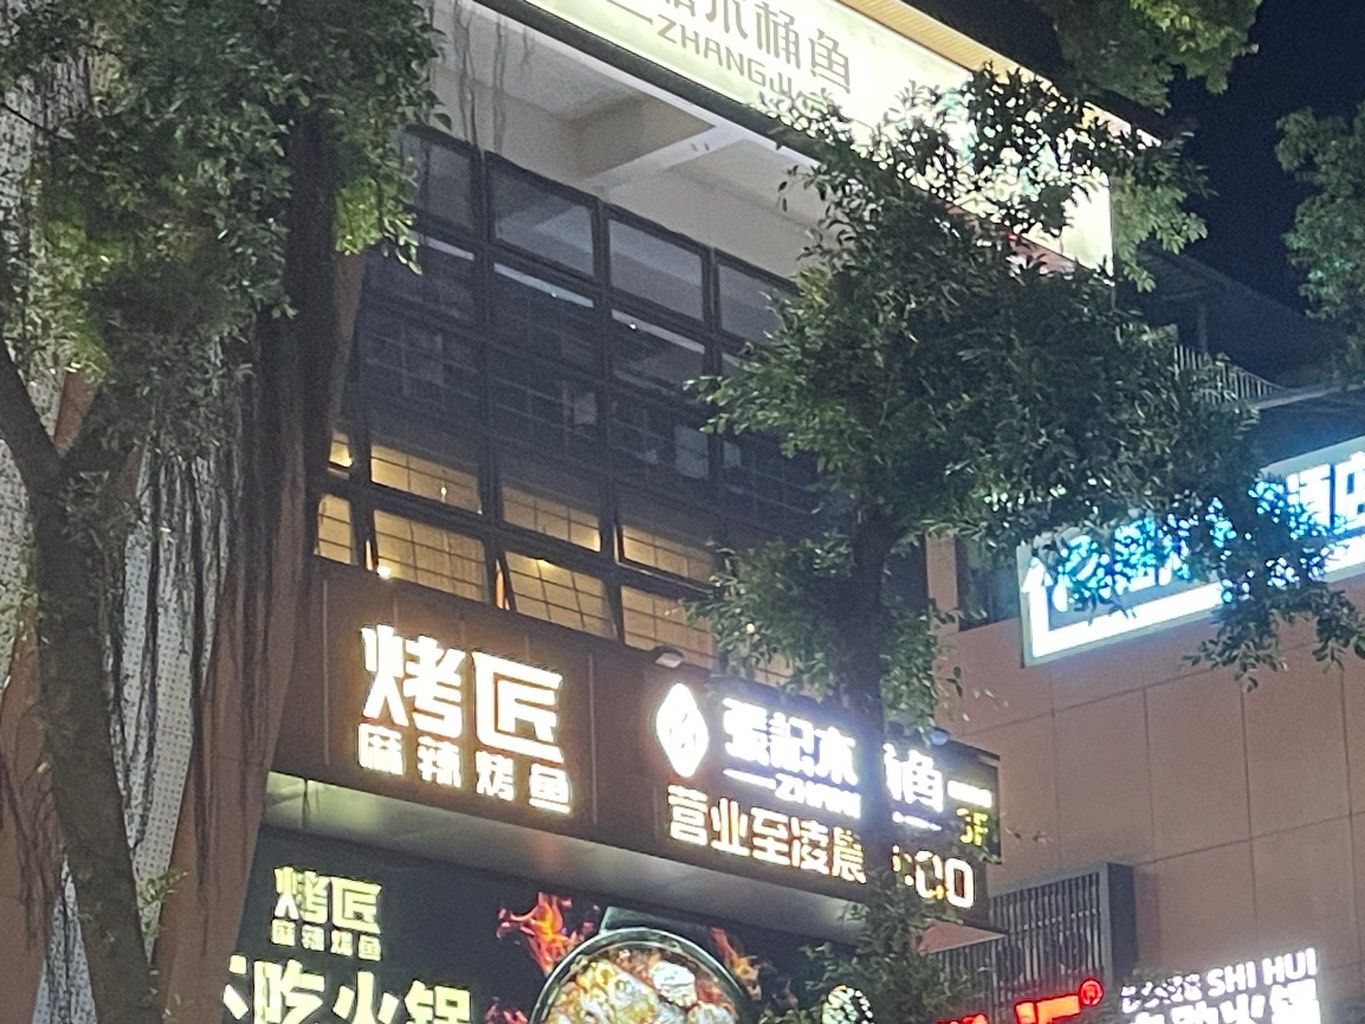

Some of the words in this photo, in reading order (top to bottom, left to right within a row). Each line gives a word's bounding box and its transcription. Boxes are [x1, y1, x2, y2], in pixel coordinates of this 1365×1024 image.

[664, 0, 851, 94] 木桶鱼
[360, 624, 563, 764] 烤匠
[273, 866, 381, 934] 烤匠
[1207, 961, 1257, 997] SHI
[1261, 947, 1318, 986] HUI
